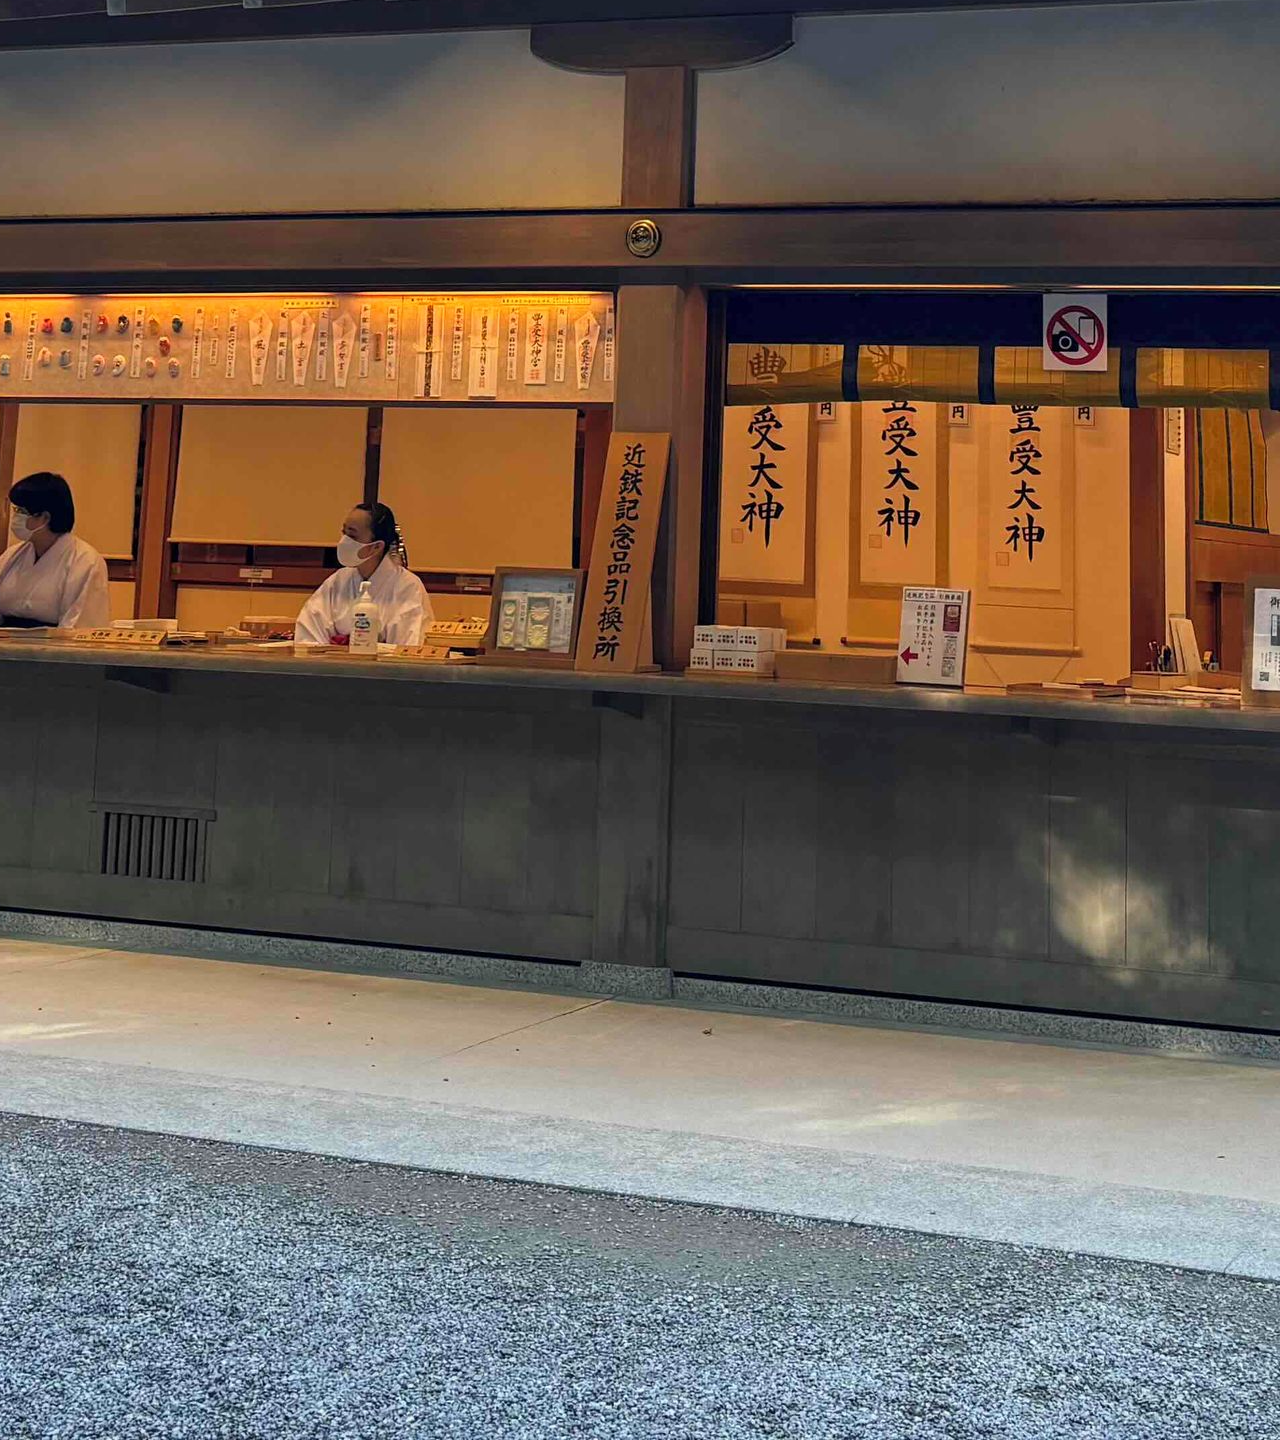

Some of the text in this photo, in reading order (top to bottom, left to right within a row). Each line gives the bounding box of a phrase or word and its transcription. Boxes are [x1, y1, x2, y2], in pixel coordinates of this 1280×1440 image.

[952, 405, 965, 419] 円
[1077, 406, 1090, 420] 円
[877, 400, 921, 548] 受大神
[592, 442, 646, 662] 近鉄記念品引換所
